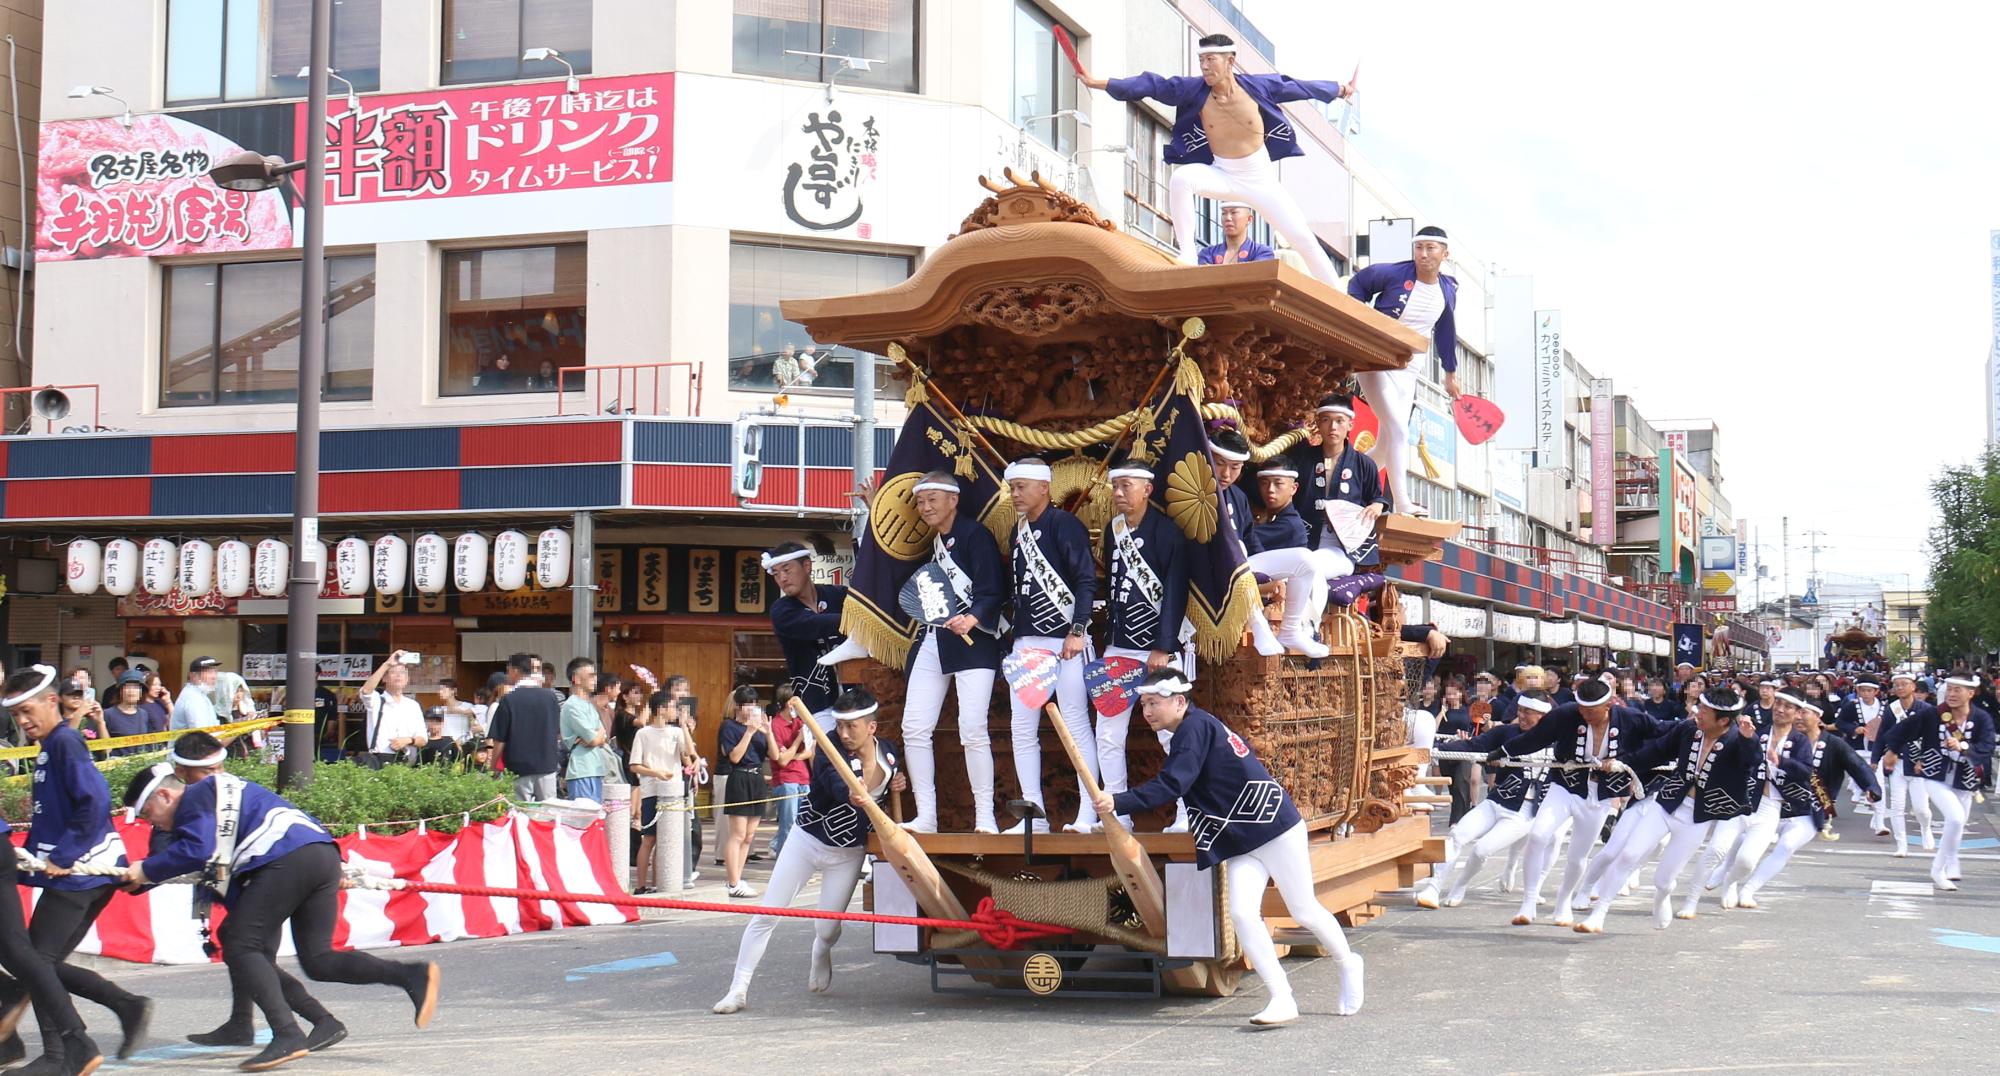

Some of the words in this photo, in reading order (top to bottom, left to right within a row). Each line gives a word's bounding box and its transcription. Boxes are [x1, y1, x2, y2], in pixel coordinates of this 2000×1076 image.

[325, 106, 446, 197] 半額
[465, 111, 659, 160] ドリンク
[91, 149, 211, 184] 名古屋名物
[466, 155, 656, 193] タイムサービス!
[50, 183, 251, 252] 手羽先唐揚
[1703, 538, 1733, 569] P
[643, 552, 662, 606] まぐろ
[693, 556, 716, 606] はまち
[343, 657, 368, 669] ラムネ
